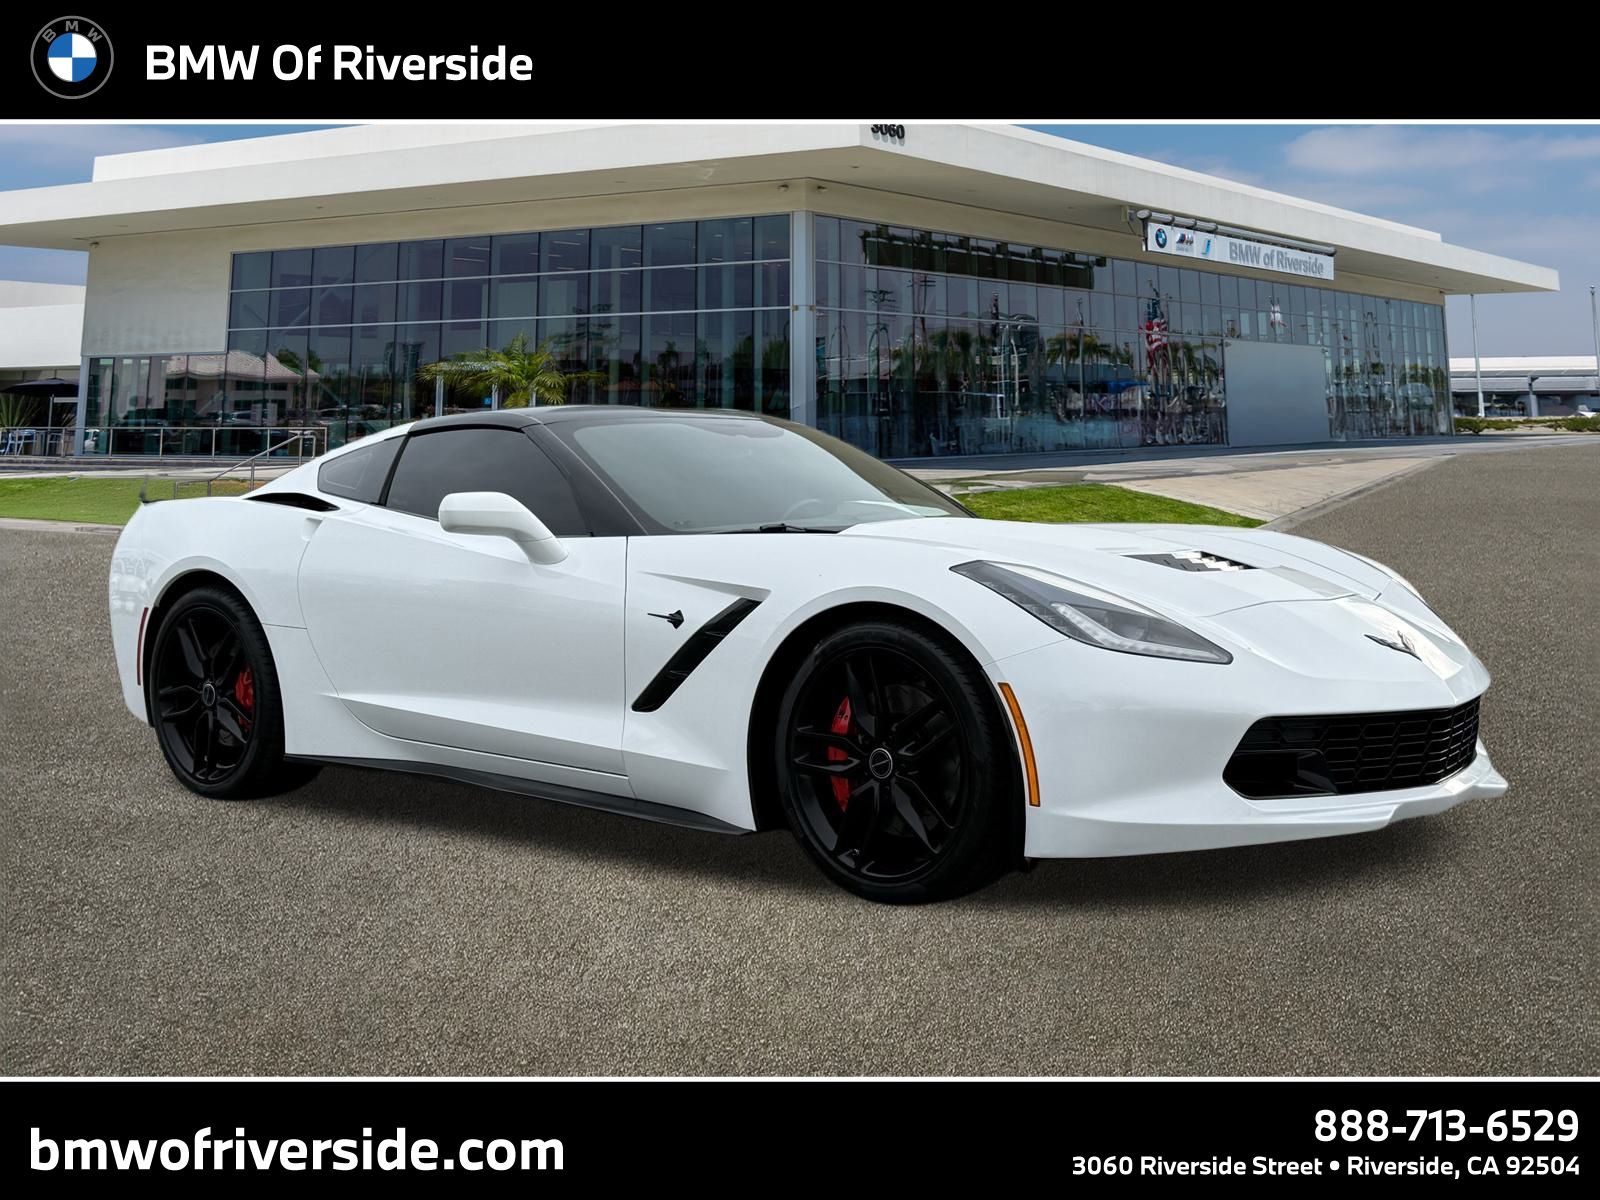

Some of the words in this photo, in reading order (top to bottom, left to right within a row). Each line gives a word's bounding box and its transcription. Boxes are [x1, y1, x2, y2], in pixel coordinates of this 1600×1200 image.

[1229, 241, 1261, 265] BMW
[1263, 249, 1275, 267] of
[1276, 250, 1324, 275] Riverside
